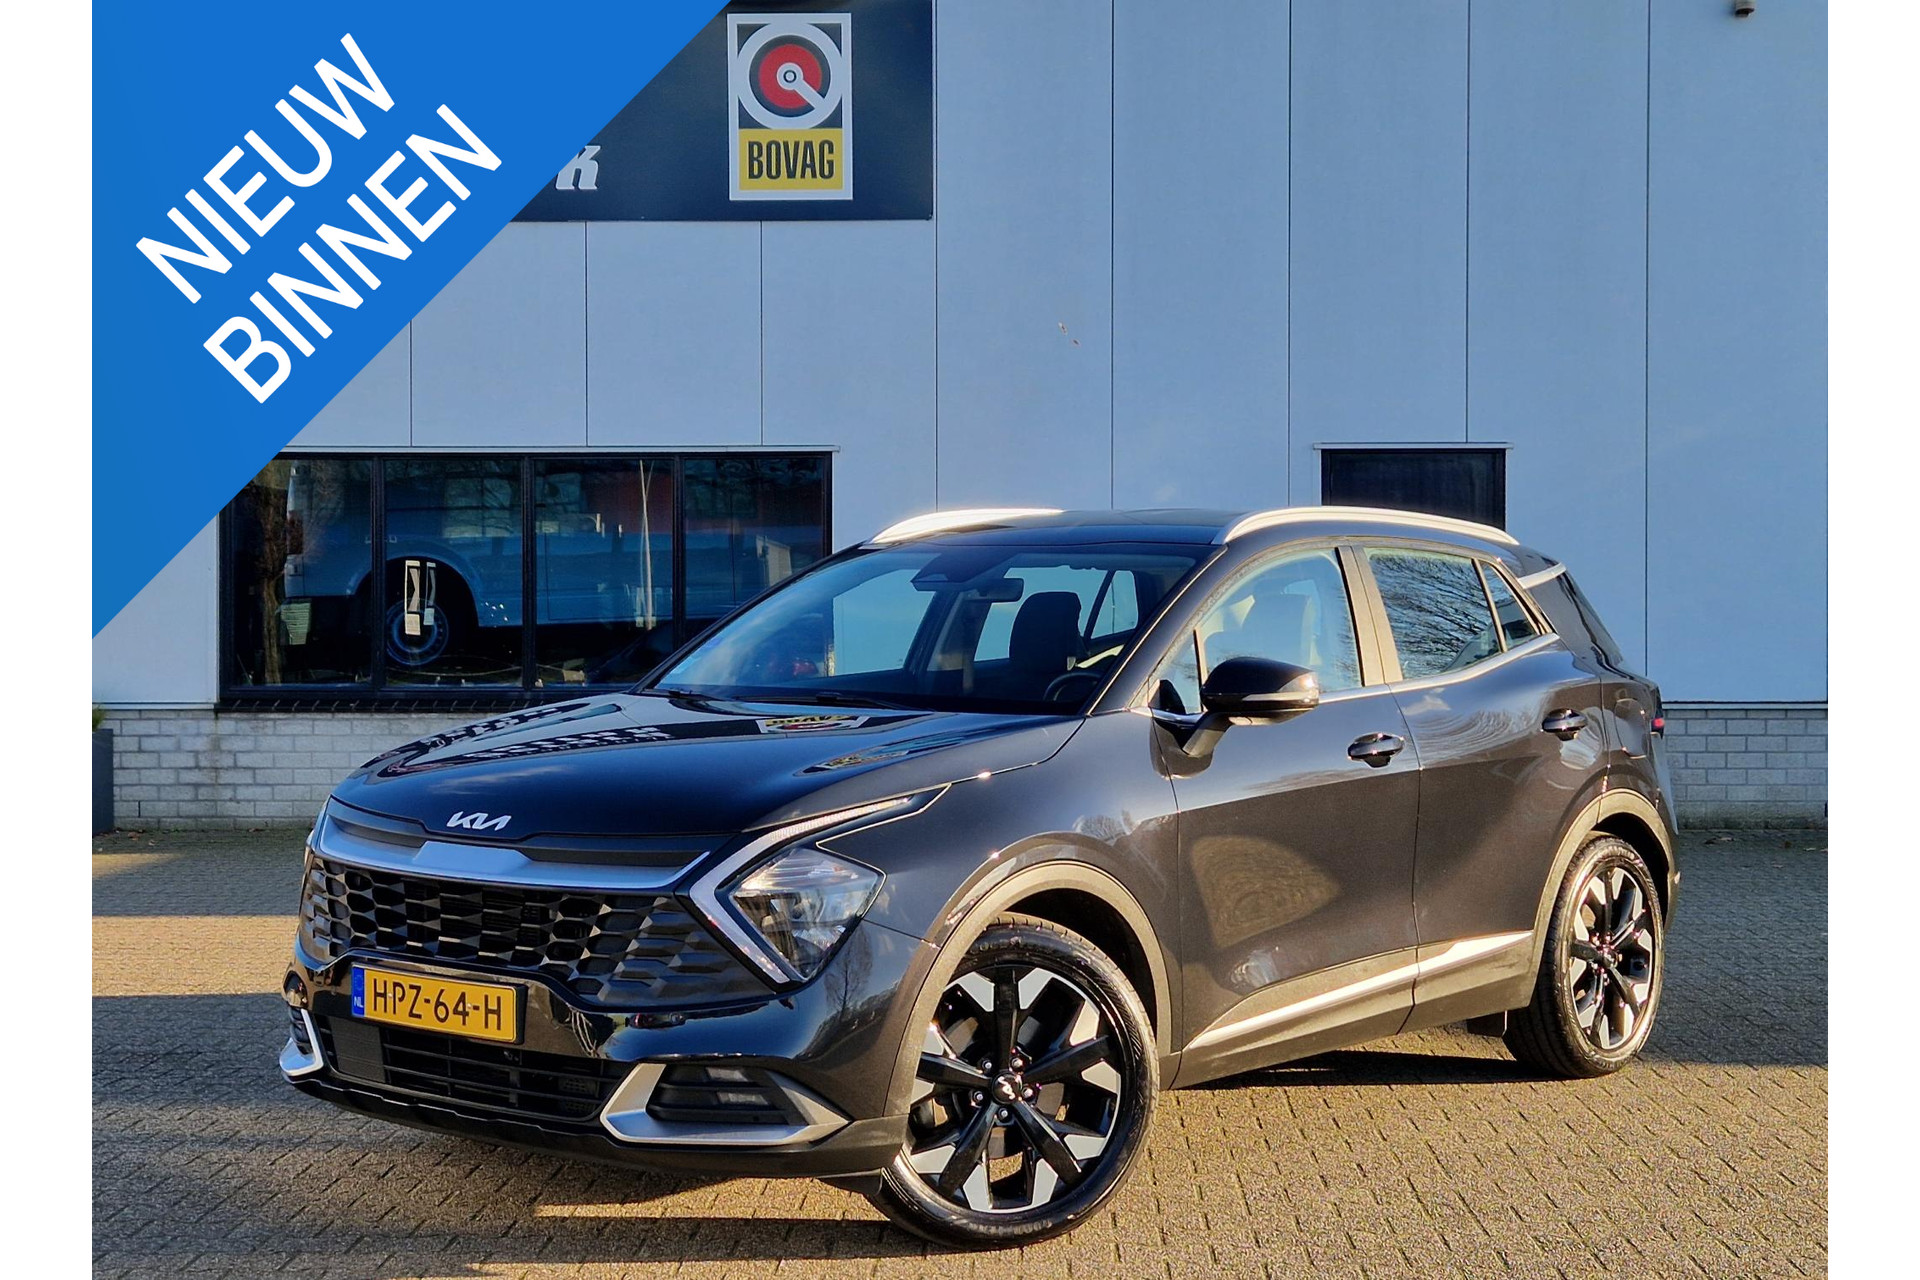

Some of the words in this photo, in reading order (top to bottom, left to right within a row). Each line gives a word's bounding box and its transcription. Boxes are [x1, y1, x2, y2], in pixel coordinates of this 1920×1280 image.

[748, 139, 834, 180] BOVAG
[353, 995, 364, 1009] NL
[373, 977, 502, 1031] HPZ-64-H
